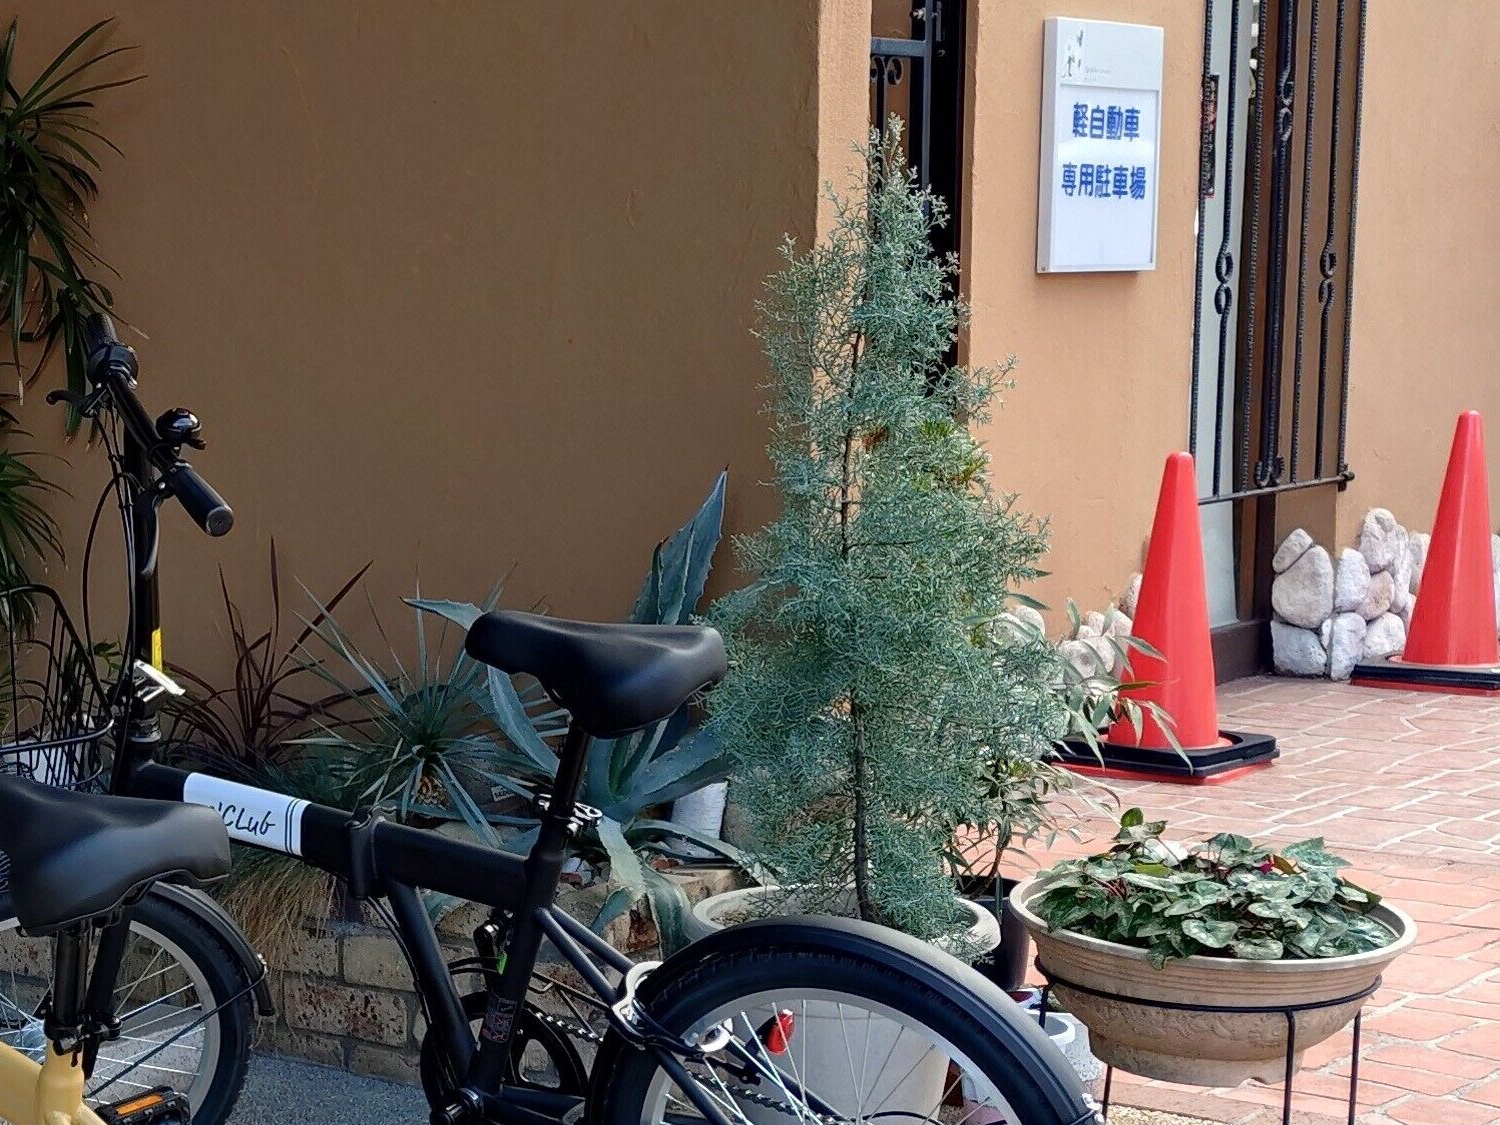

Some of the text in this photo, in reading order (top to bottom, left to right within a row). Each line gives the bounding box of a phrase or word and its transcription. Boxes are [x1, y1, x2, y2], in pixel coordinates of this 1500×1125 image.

[1072, 102, 1141, 142] 軽自動車
[1061, 162, 1147, 200] 専用駐車場
